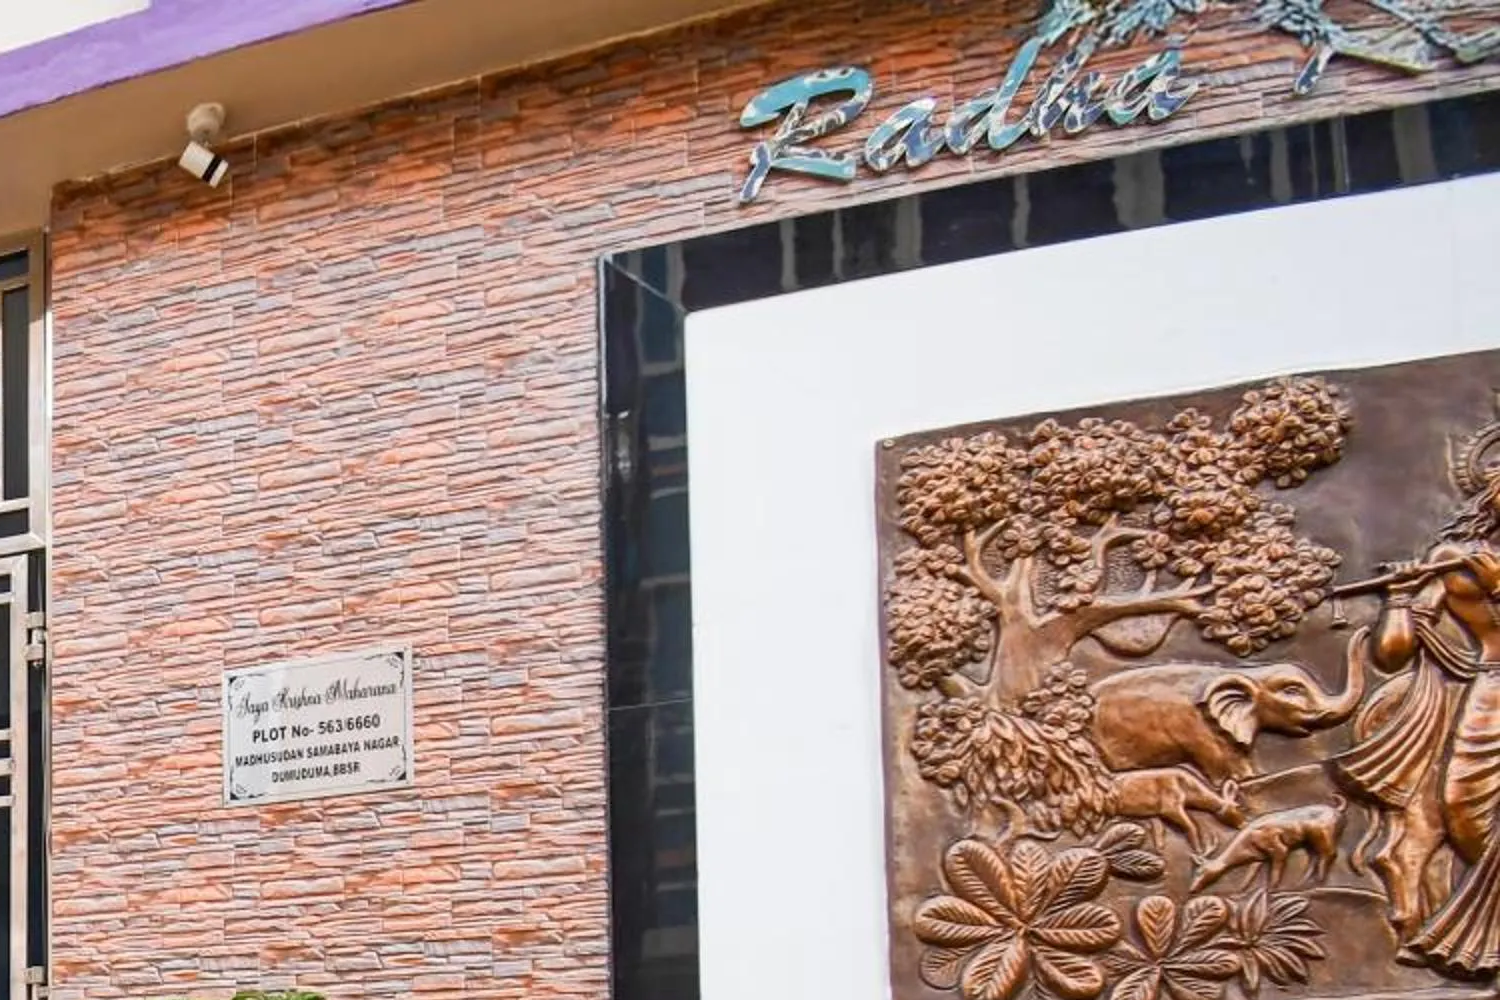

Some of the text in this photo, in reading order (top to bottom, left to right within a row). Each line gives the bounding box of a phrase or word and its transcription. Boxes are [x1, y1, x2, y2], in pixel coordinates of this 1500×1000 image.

[252, 726, 286, 744] PLOT
[235, 735, 400, 768] MADHUSUDAN SAMABAYA NAGAR
